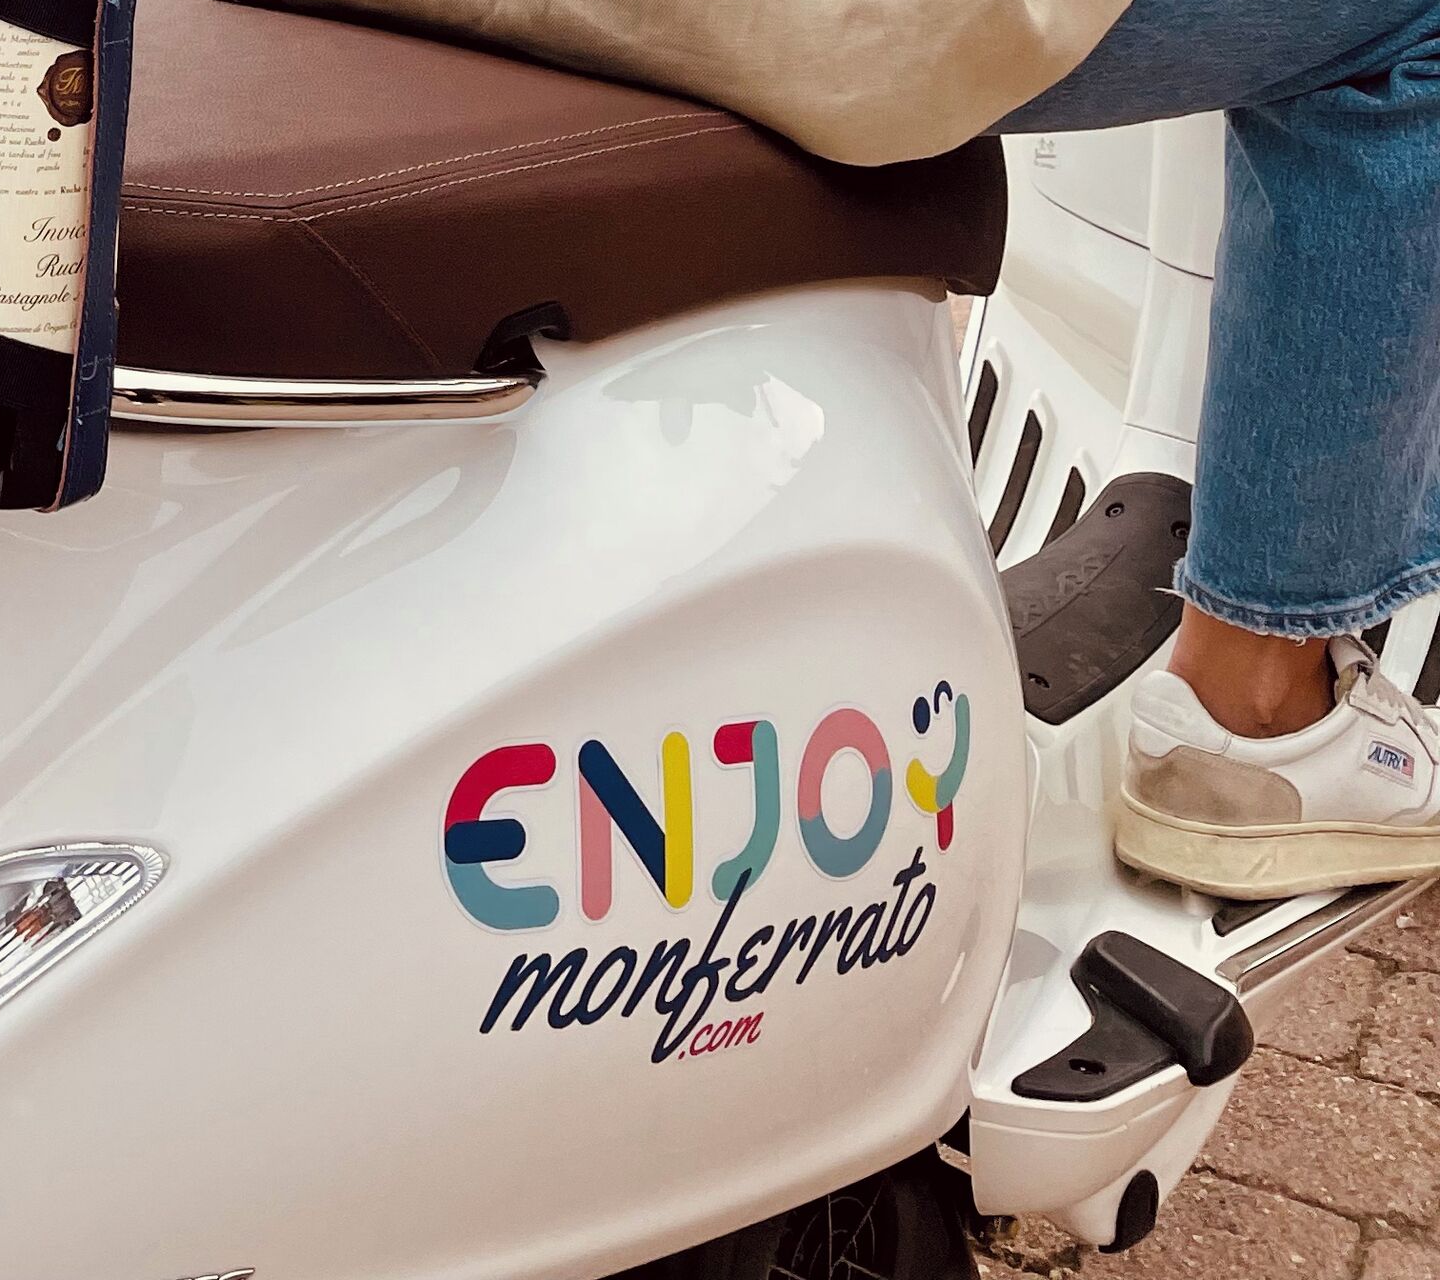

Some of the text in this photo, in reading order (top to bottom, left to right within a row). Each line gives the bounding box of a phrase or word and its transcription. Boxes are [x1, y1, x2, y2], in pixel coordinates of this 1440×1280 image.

[444, 680, 970, 930] ENJOY
[1367, 745, 1402, 771] AUTRY
[479, 846, 936, 1064] monferrato
[678, 1012, 764, 1060] .com
